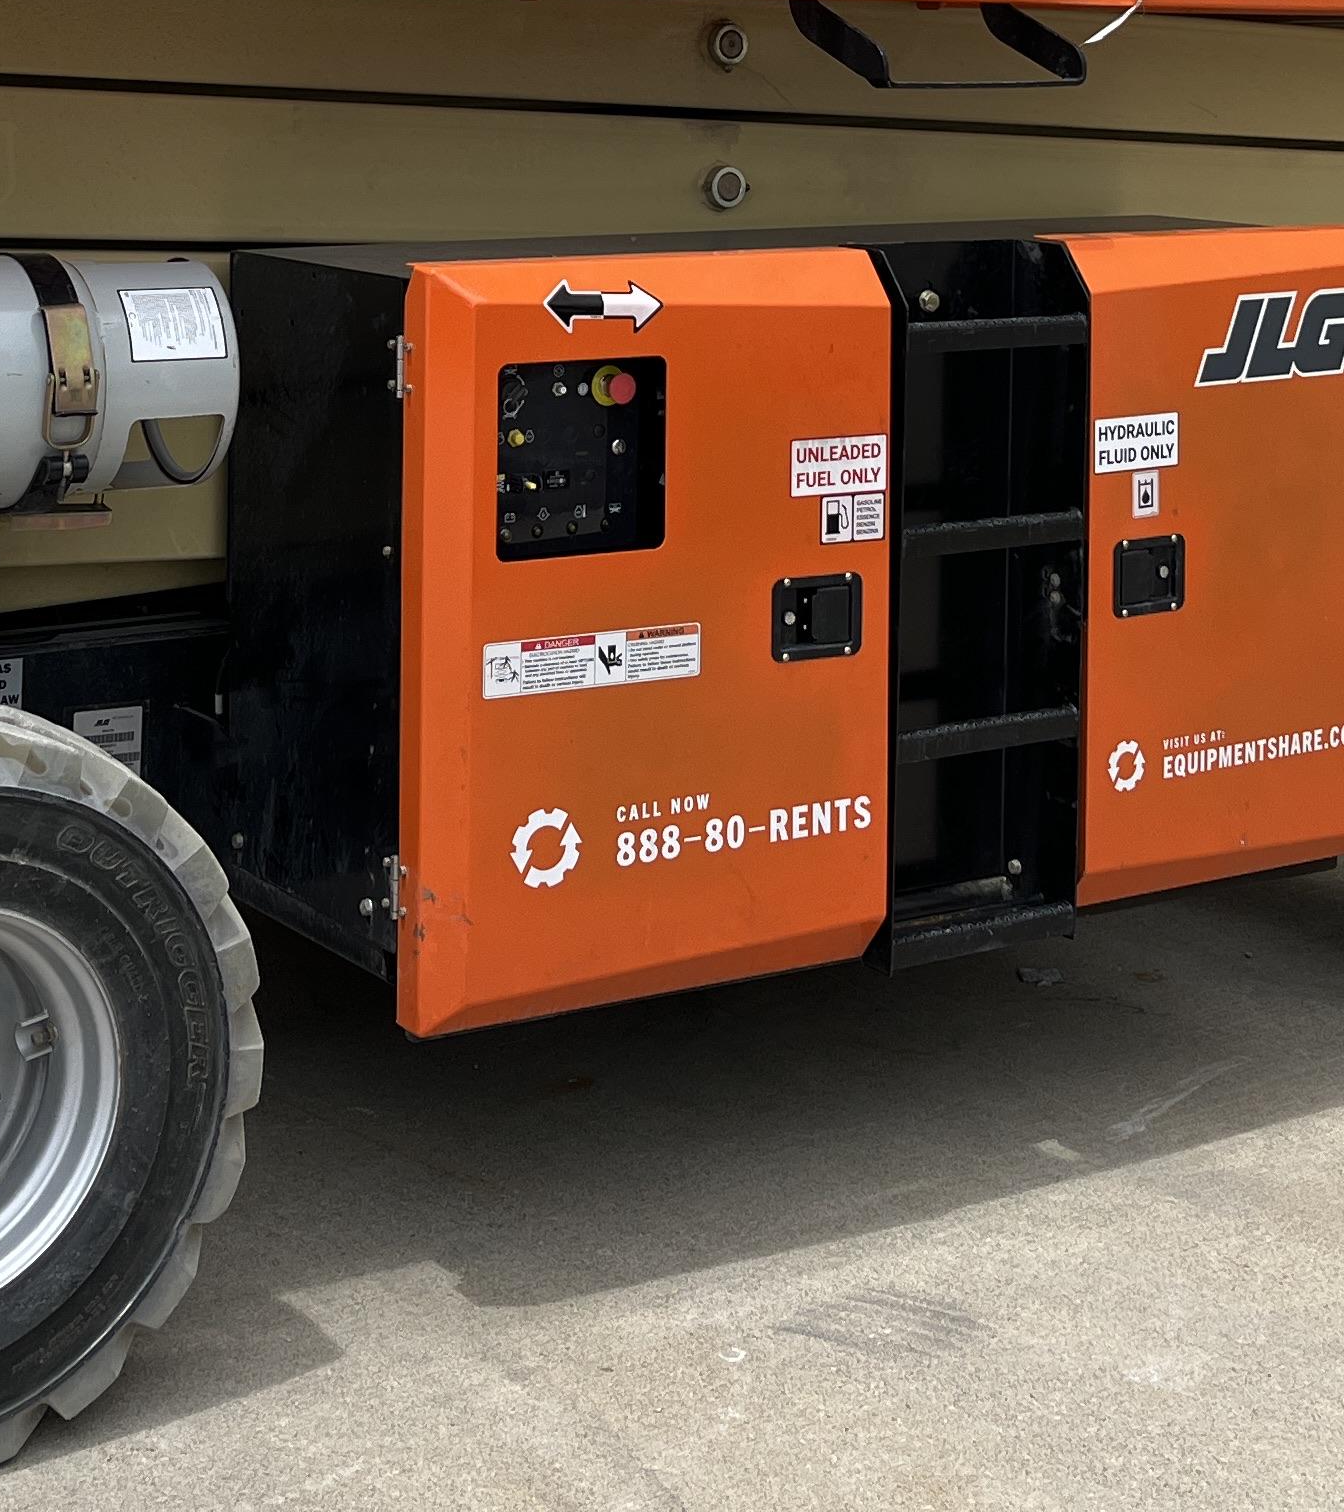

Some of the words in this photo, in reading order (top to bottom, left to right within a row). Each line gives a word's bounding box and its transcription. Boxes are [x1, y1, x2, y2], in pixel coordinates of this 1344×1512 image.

[1098, 420, 1175, 442] HYDRAULIC
[796, 443, 881, 463] UNLEADED
[1098, 447, 1137, 466] FLUID
[1140, 443, 1175, 461] ONLY
[796, 470, 836, 489] FUEL
[840, 467, 881, 485] ONLY
[544, 638, 579, 649] DANGER
[647, 627, 685, 638] WARNING
[1163, 735, 1190, 750] VISIT
[1194, 733, 1206, 745] US
[616, 801, 661, 823] CALL
[671, 793, 710, 815] NOW
[616, 795, 872, 867] 888-80-RENTS
